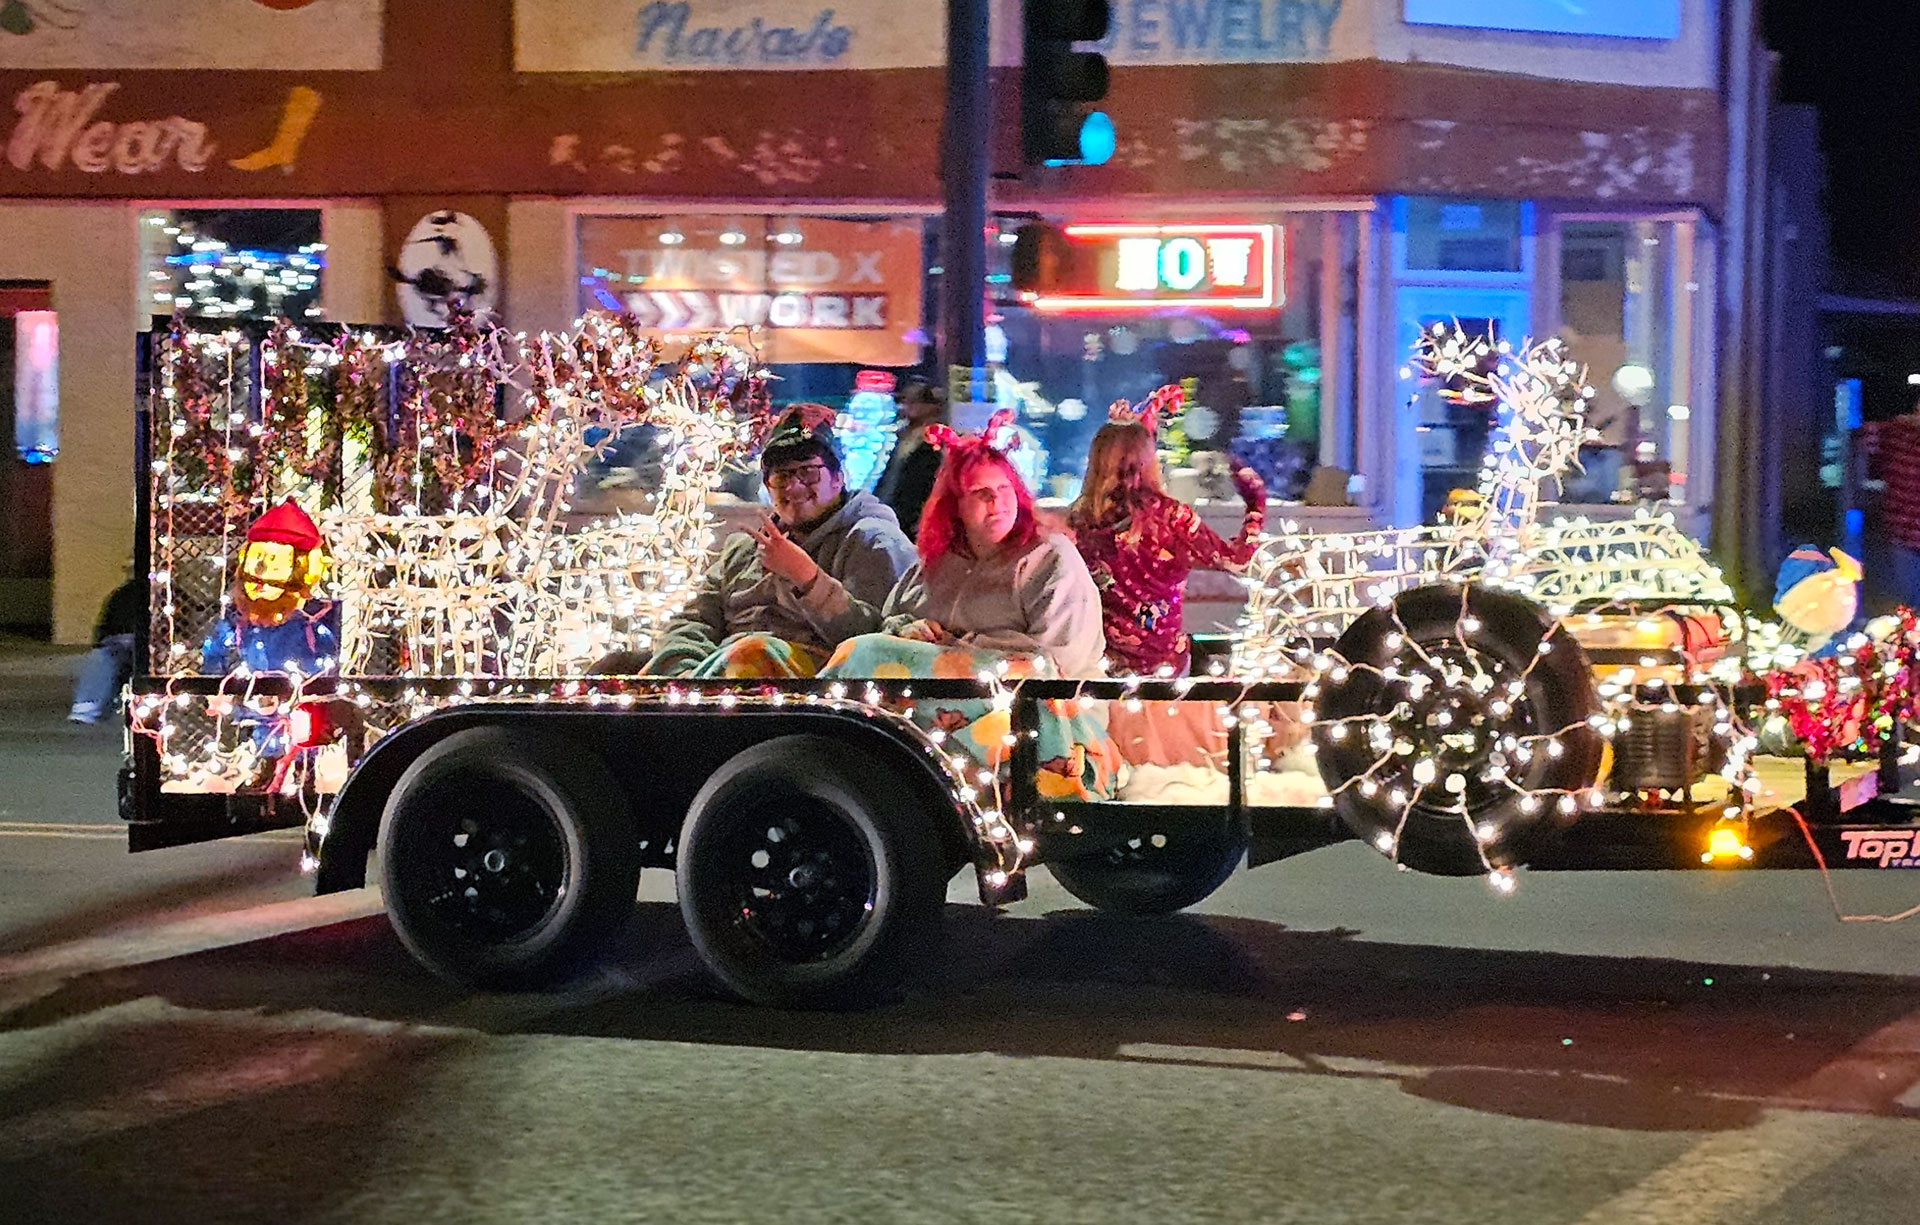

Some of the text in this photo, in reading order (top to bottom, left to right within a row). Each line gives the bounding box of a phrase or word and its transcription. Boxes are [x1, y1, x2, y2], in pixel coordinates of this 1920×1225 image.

[7, 80, 217, 174] Wear
[852, 251, 885, 284] X
[718, 293, 886, 327] WORK
